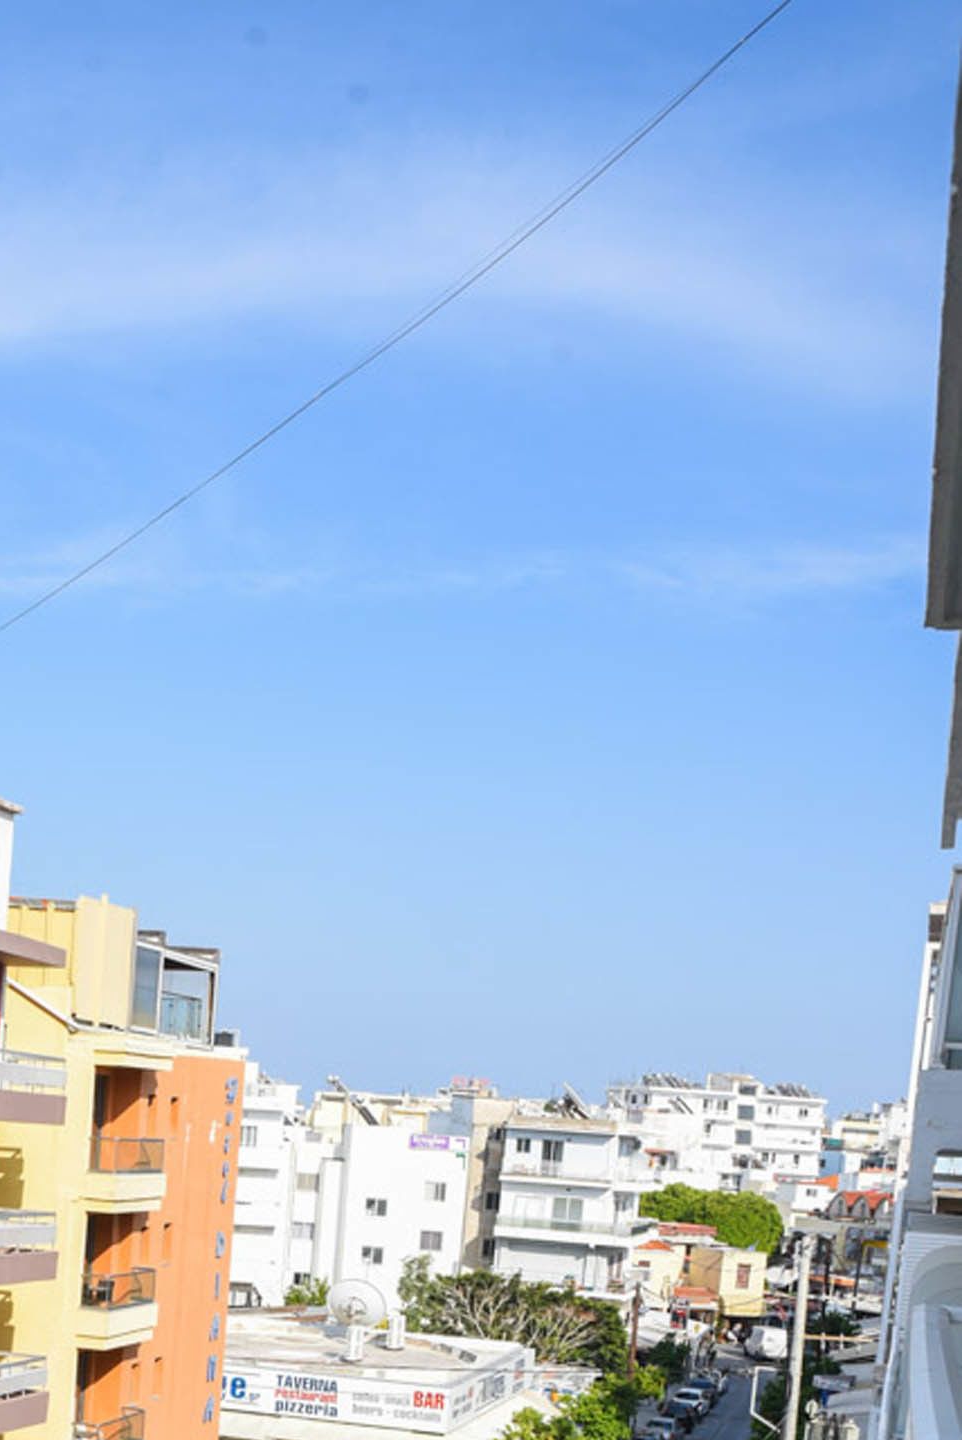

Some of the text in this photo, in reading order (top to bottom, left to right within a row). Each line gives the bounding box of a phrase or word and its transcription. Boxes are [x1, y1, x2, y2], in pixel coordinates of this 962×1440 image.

[276, 1374, 338, 1392] TAVERNA
[274, 1400, 338, 1418] pizzeria
[413, 1391, 445, 1410] BAR
